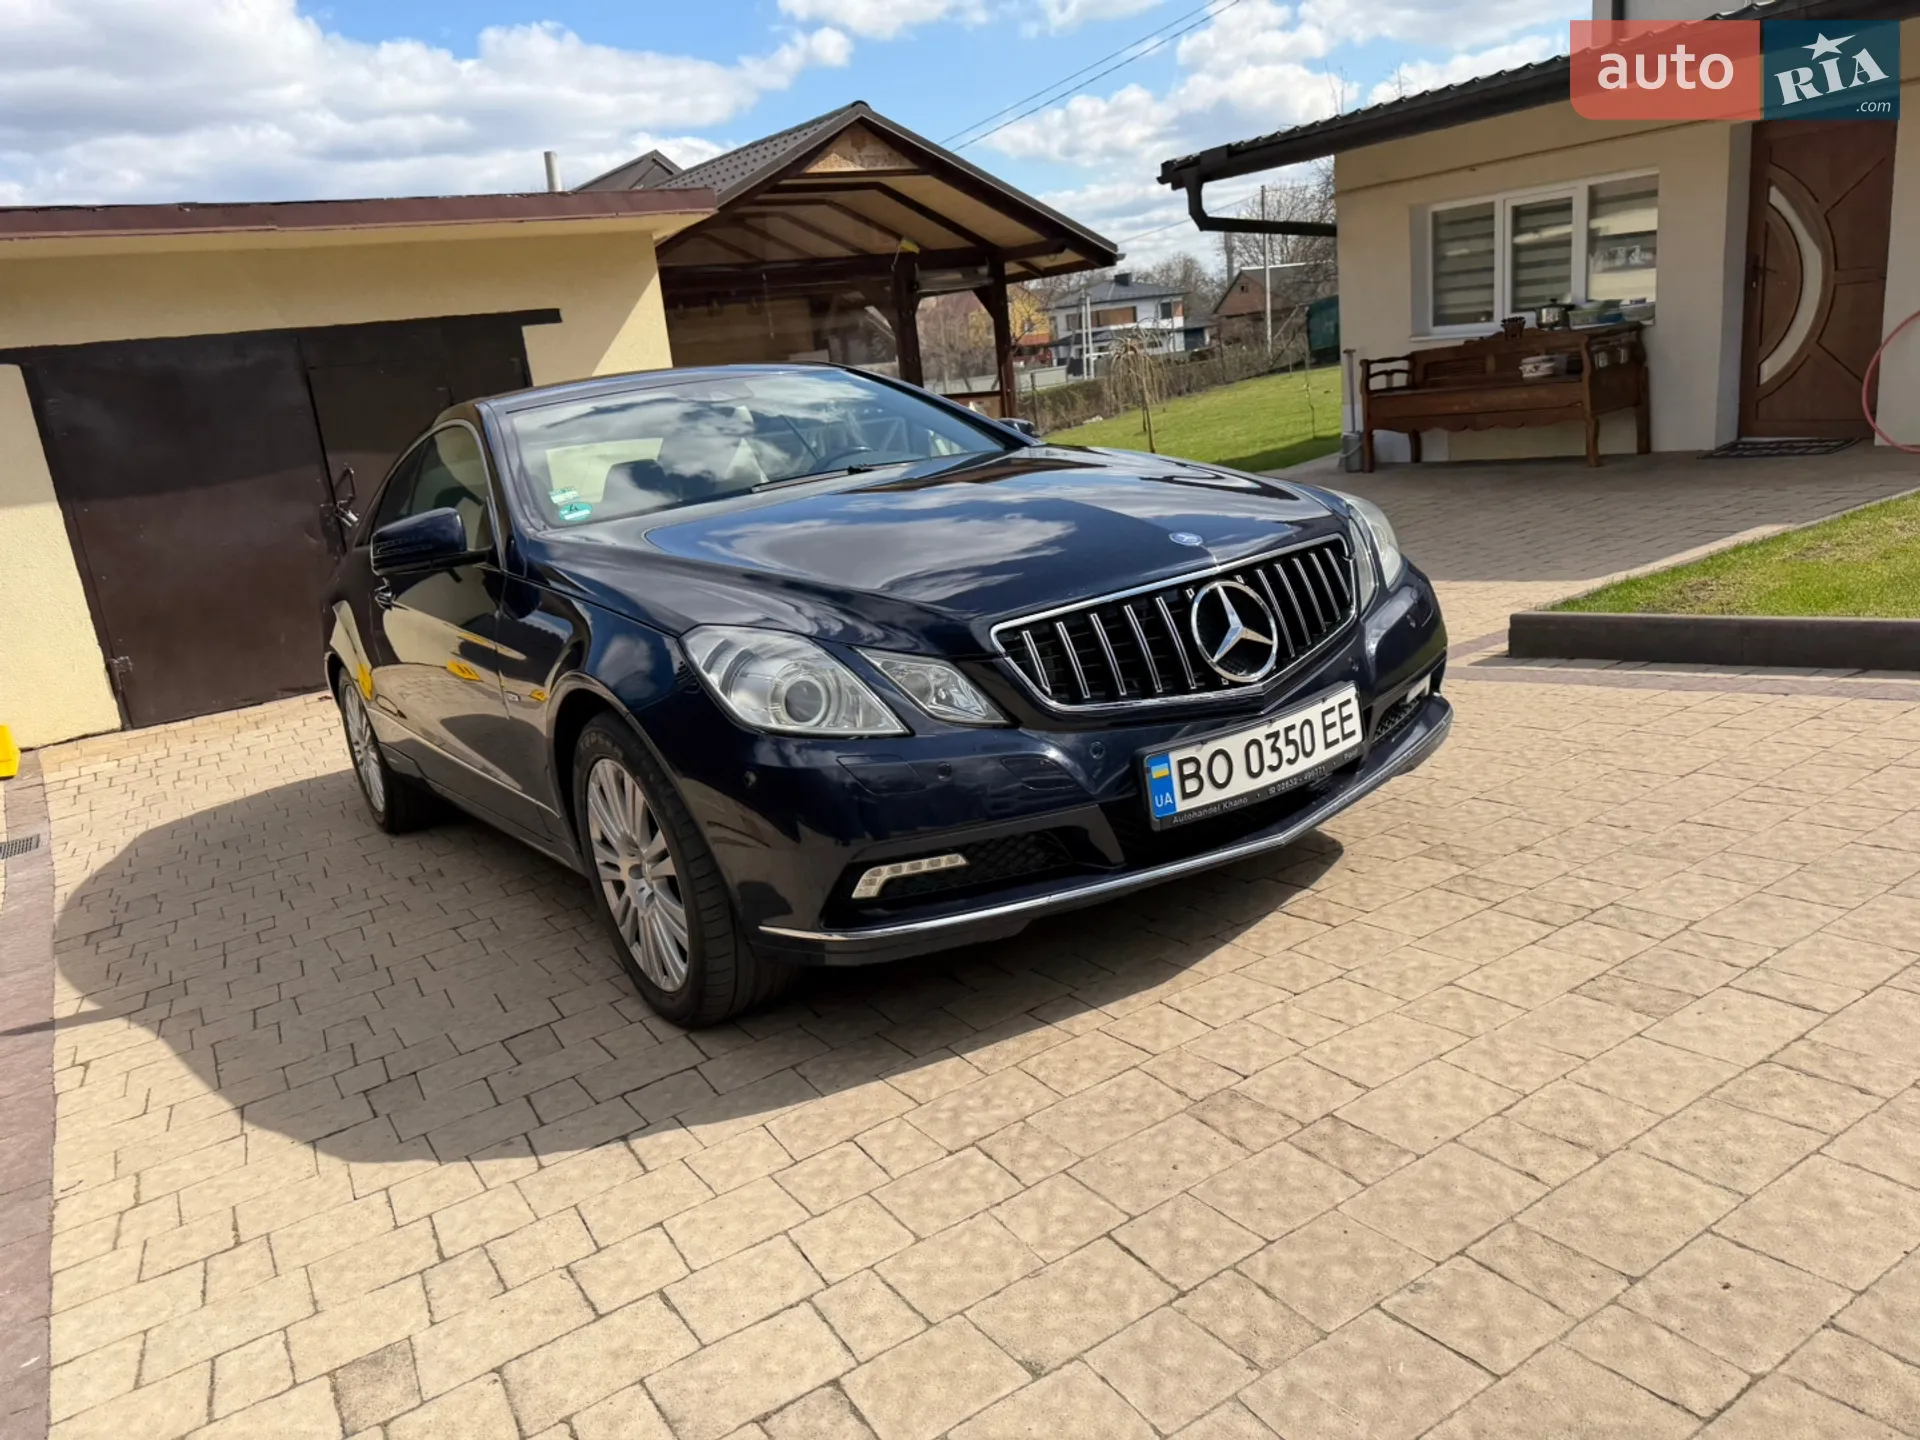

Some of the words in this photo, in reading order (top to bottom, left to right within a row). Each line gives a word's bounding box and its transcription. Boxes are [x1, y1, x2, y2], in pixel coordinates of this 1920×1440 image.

[1177, 749, 1233, 800] BO
[1244, 718, 1316, 778] 0350
[1321, 698, 1357, 750] EE
[1155, 792, 1173, 807] UA
[1172, 806, 1222, 824] Autohandel
